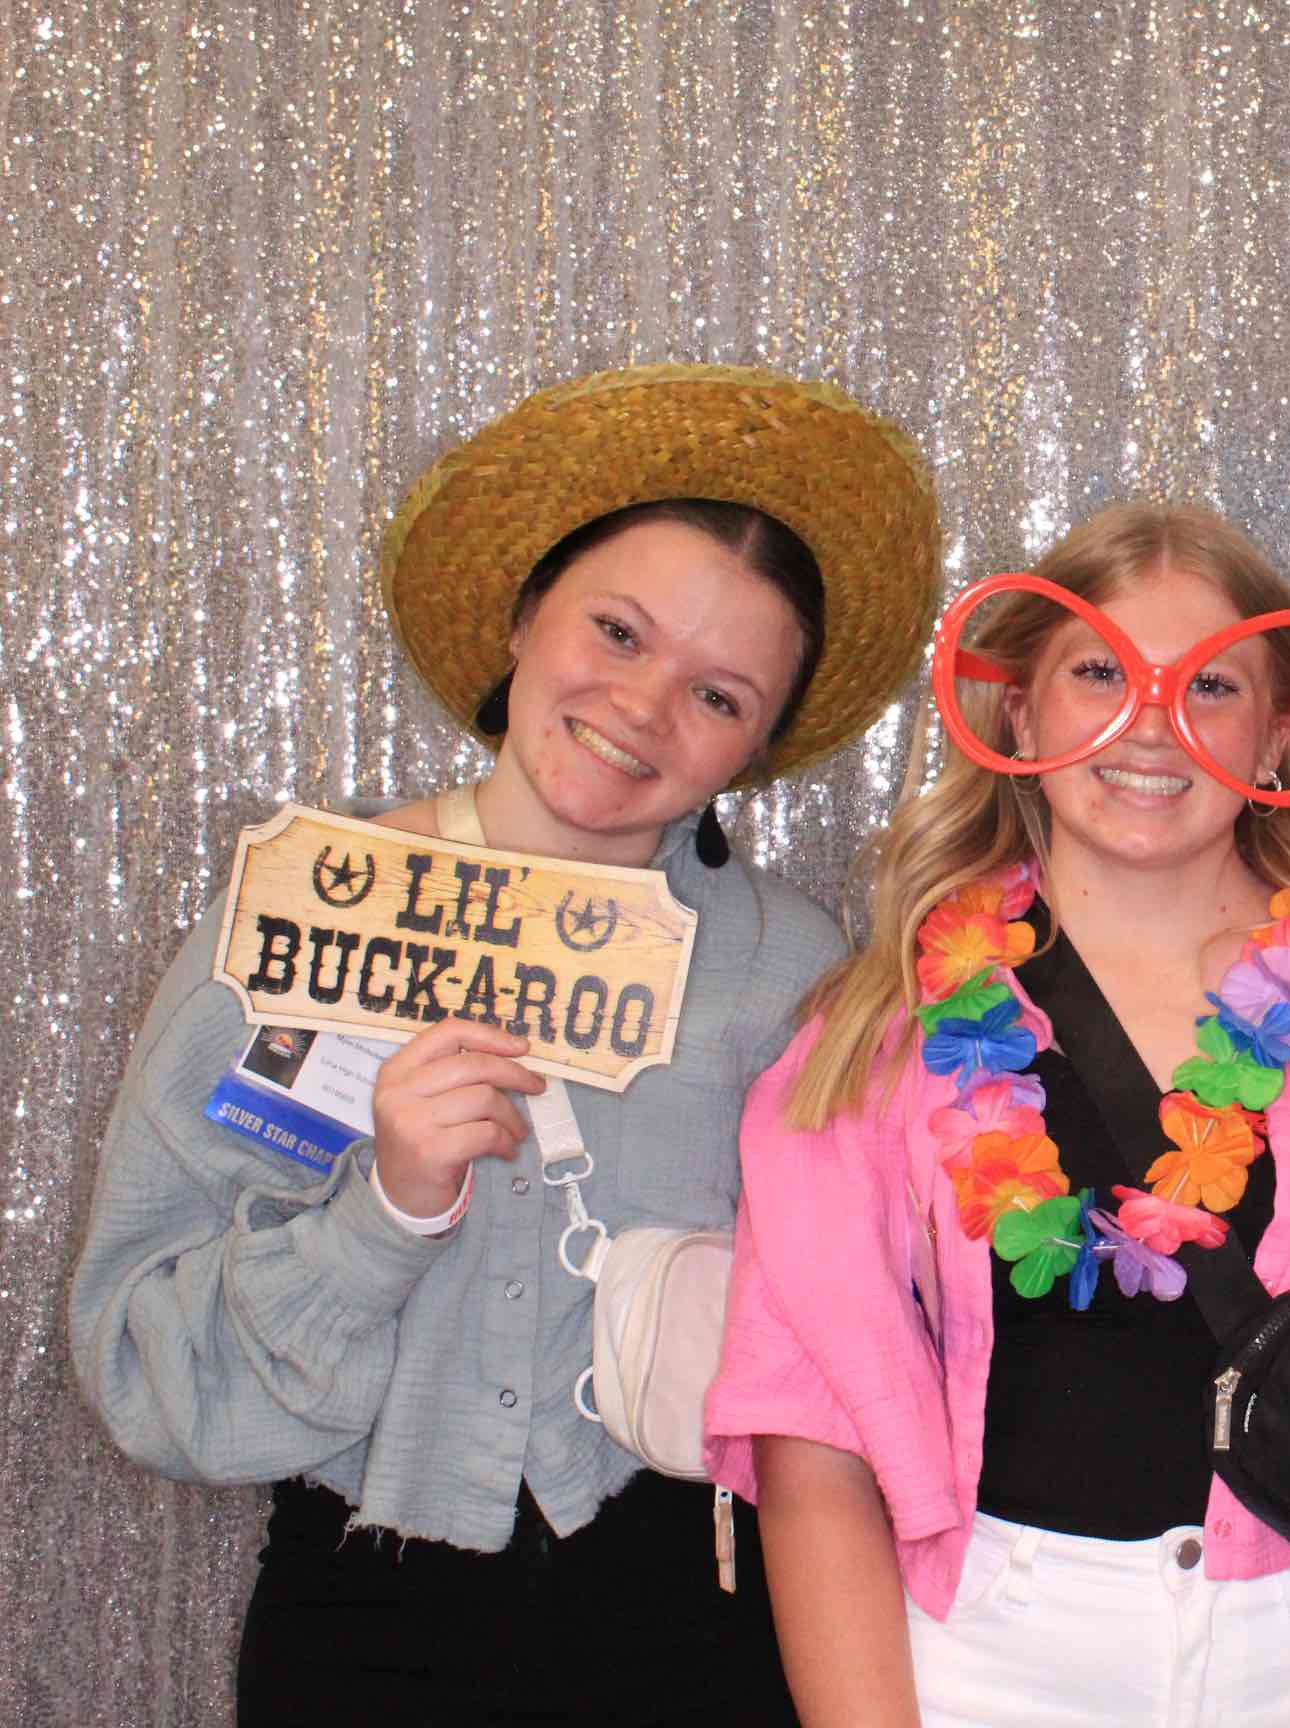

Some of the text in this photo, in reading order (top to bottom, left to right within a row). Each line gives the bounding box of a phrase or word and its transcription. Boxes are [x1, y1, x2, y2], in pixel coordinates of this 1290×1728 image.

[394, 852, 531, 948] LIL'
[247, 914, 655, 1057] BUCK-A-ROO
[217, 1102, 337, 1166] SILVER STAR CHAP
